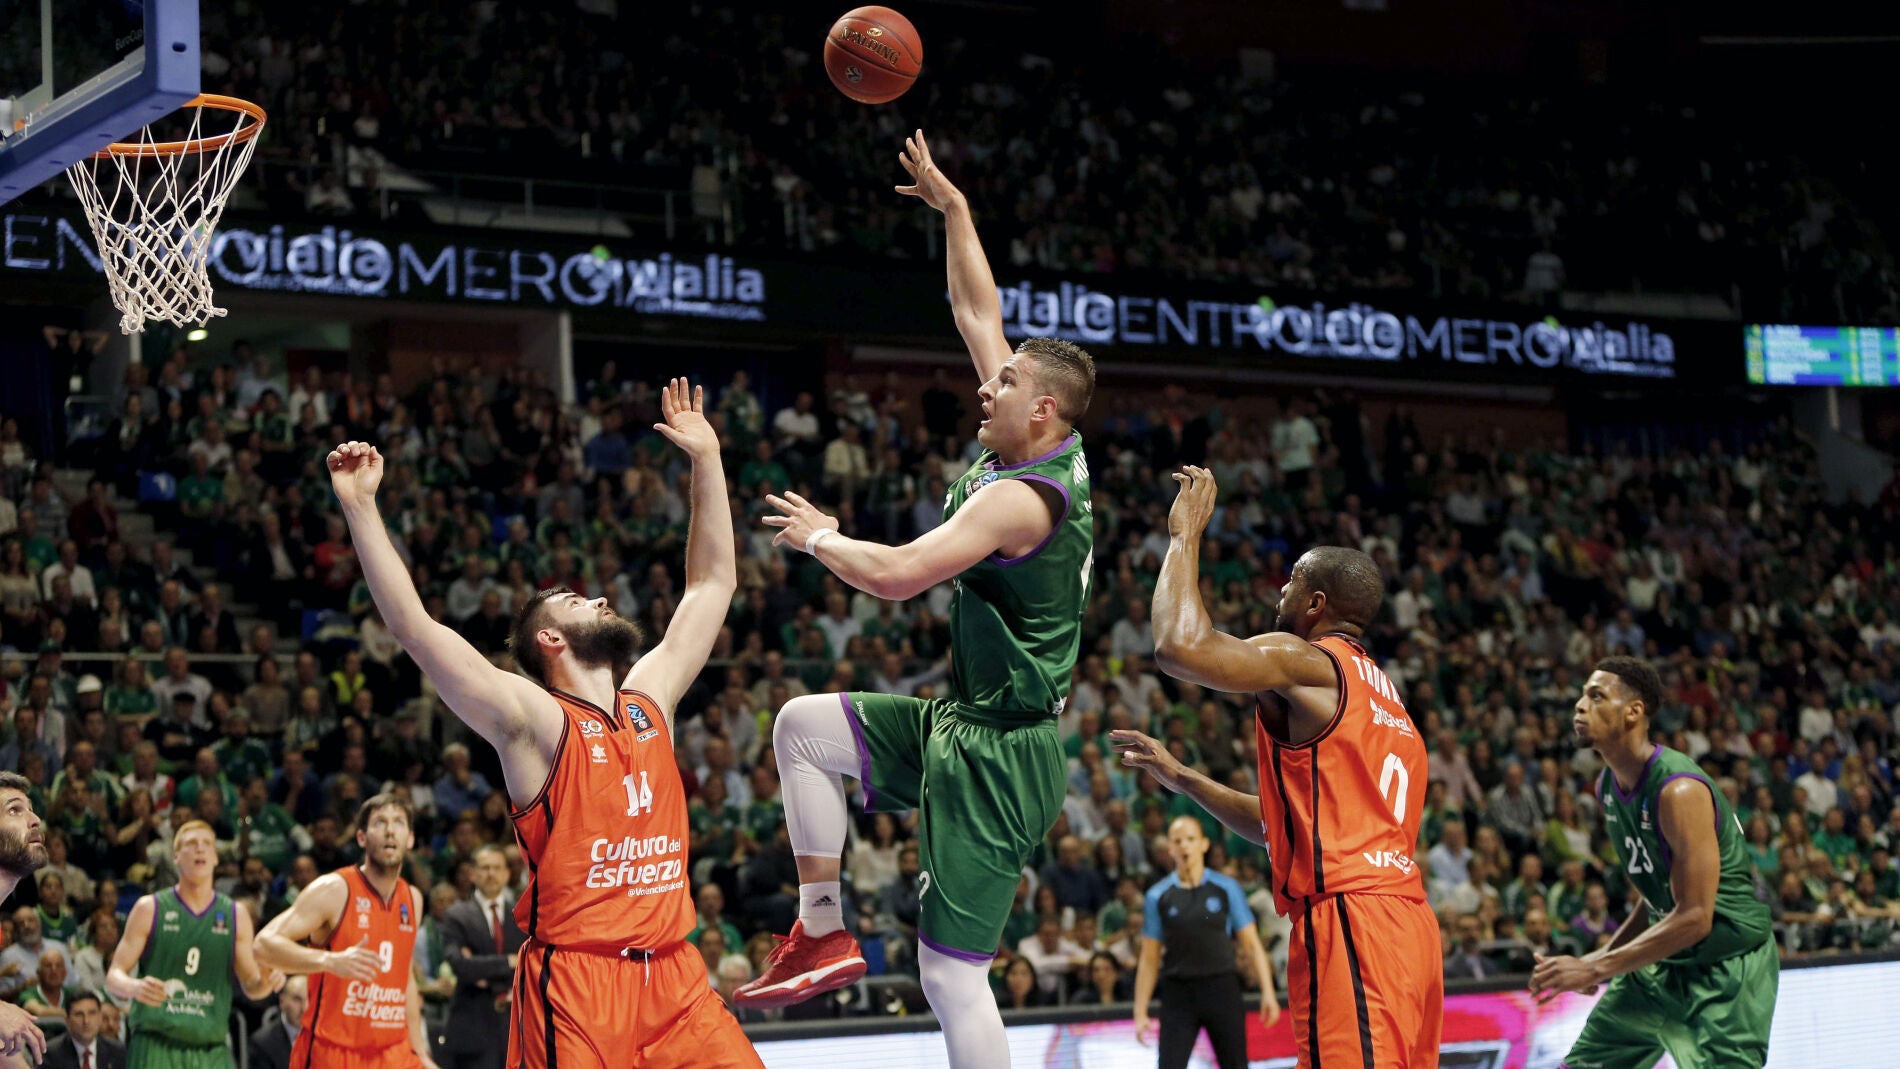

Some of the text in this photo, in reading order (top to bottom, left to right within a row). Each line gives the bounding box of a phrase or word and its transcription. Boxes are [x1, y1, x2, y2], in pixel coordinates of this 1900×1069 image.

[1351, 655, 1406, 711] THOMA
[622, 771, 653, 817] 14
[590, 835, 668, 863] Cultura
[1624, 836, 1654, 874] 23
[586, 859, 682, 889] Esfuerzo
[184, 946, 201, 977] 9
[379, 940, 394, 973] 9
[347, 980, 402, 1003] Cultura
